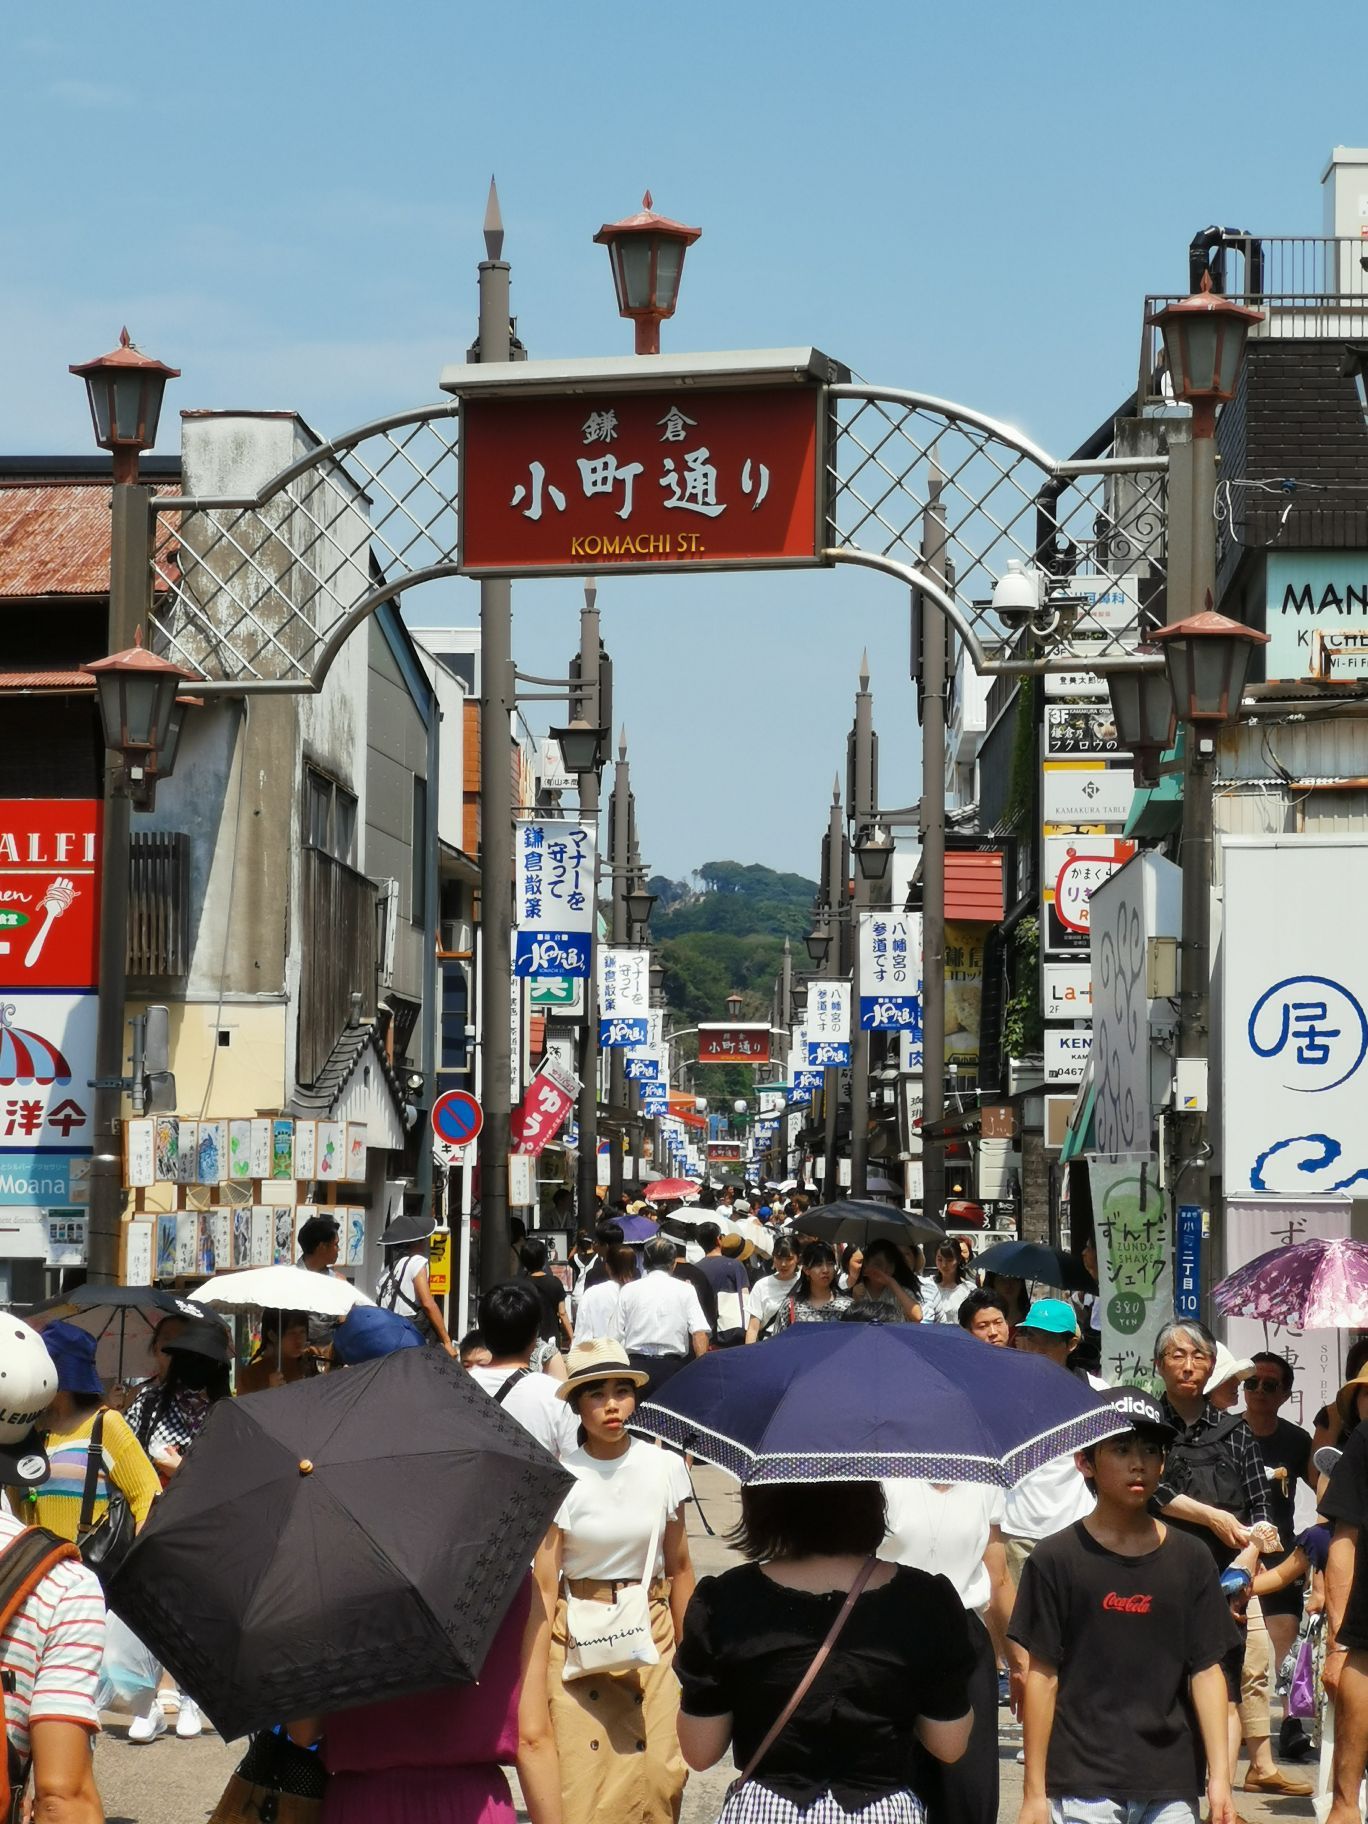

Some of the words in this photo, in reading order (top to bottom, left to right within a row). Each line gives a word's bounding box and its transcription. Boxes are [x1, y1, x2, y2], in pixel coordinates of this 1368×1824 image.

[581, 405, 697, 445] 鎌倉
[509, 447, 770, 521] 小町通り
[571, 535, 670, 556] KOMACHI
[677, 533, 706, 553] ST.
[1050, 709, 1069, 725] 3F
[1051, 739, 1118, 752] フクロウの
[1055, 806, 1101, 815] KAMAKURA
[1103, 805, 1127, 814] TABLE
[523, 826, 545, 919] 鎌倉散策
[547, 842, 568, 899] 守って
[567, 830, 588, 912] マナーを
[872, 921, 888, 983] 参道です
[892, 921, 907, 982] 八幡宮の
[632, 955, 644, 1006] マナーを
[817, 989, 828, 1033] 参道です
[831, 989, 842, 1033] 八幡宮の
[1049, 1005, 1060, 1014] 2F
[708, 1040, 761, 1055] 小町通り
[1058, 1068, 1084, 1076] 0467
[1098, 1211, 1167, 1249] ずんだ
[1117, 1241, 1155, 1252] ZUNDA
[1118, 1253, 1155, 1264] SHAKE
[1106, 1260, 1167, 1286] シェイク
[1115, 1302, 1140, 1314] 380
[1180, 1295, 1197, 1310] 10
[1119, 1318, 1138, 1326] YEN
[1320, 1345, 1329, 1373] SOY
